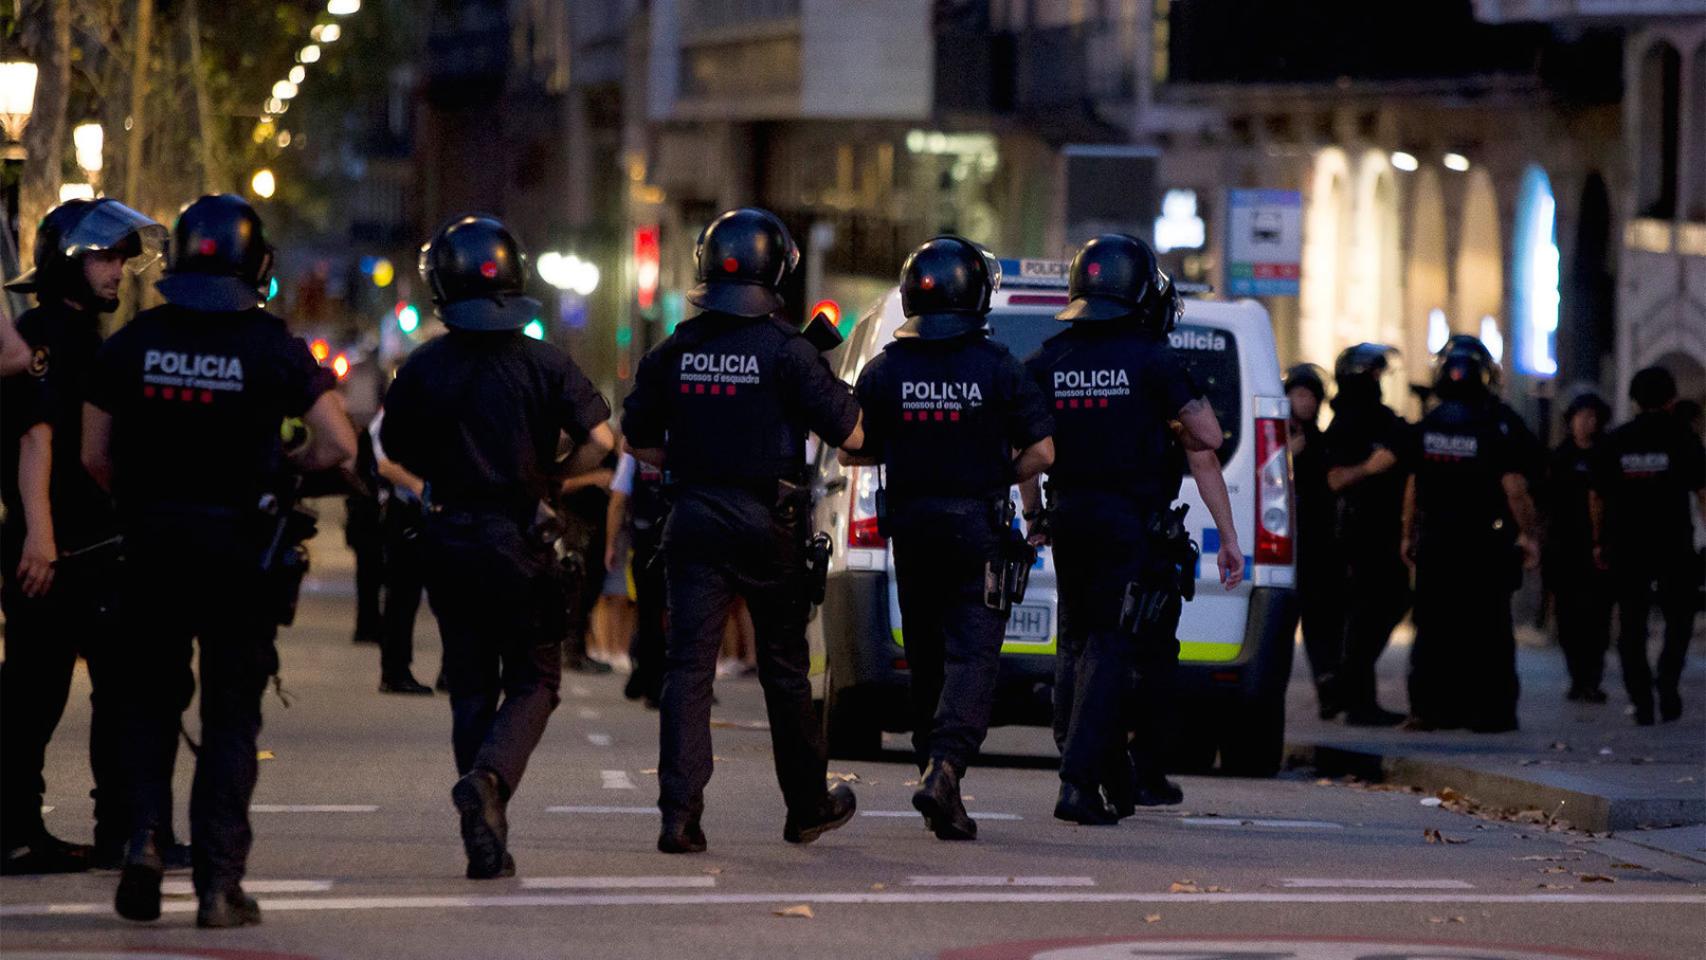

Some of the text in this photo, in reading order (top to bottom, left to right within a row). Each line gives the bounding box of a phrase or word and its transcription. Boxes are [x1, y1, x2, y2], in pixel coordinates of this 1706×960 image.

[1168, 331, 1226, 351] olicia
[144, 349, 244, 381] POLICIA
[681, 352, 760, 374] POLICIA
[680, 373, 760, 385] mossos d'esquadra
[1053, 368, 1130, 389] POLICIA
[902, 381, 983, 400] POLICIA
[1055, 386, 1130, 398] mossos d'esquadra
[903, 400, 935, 410] mossos
